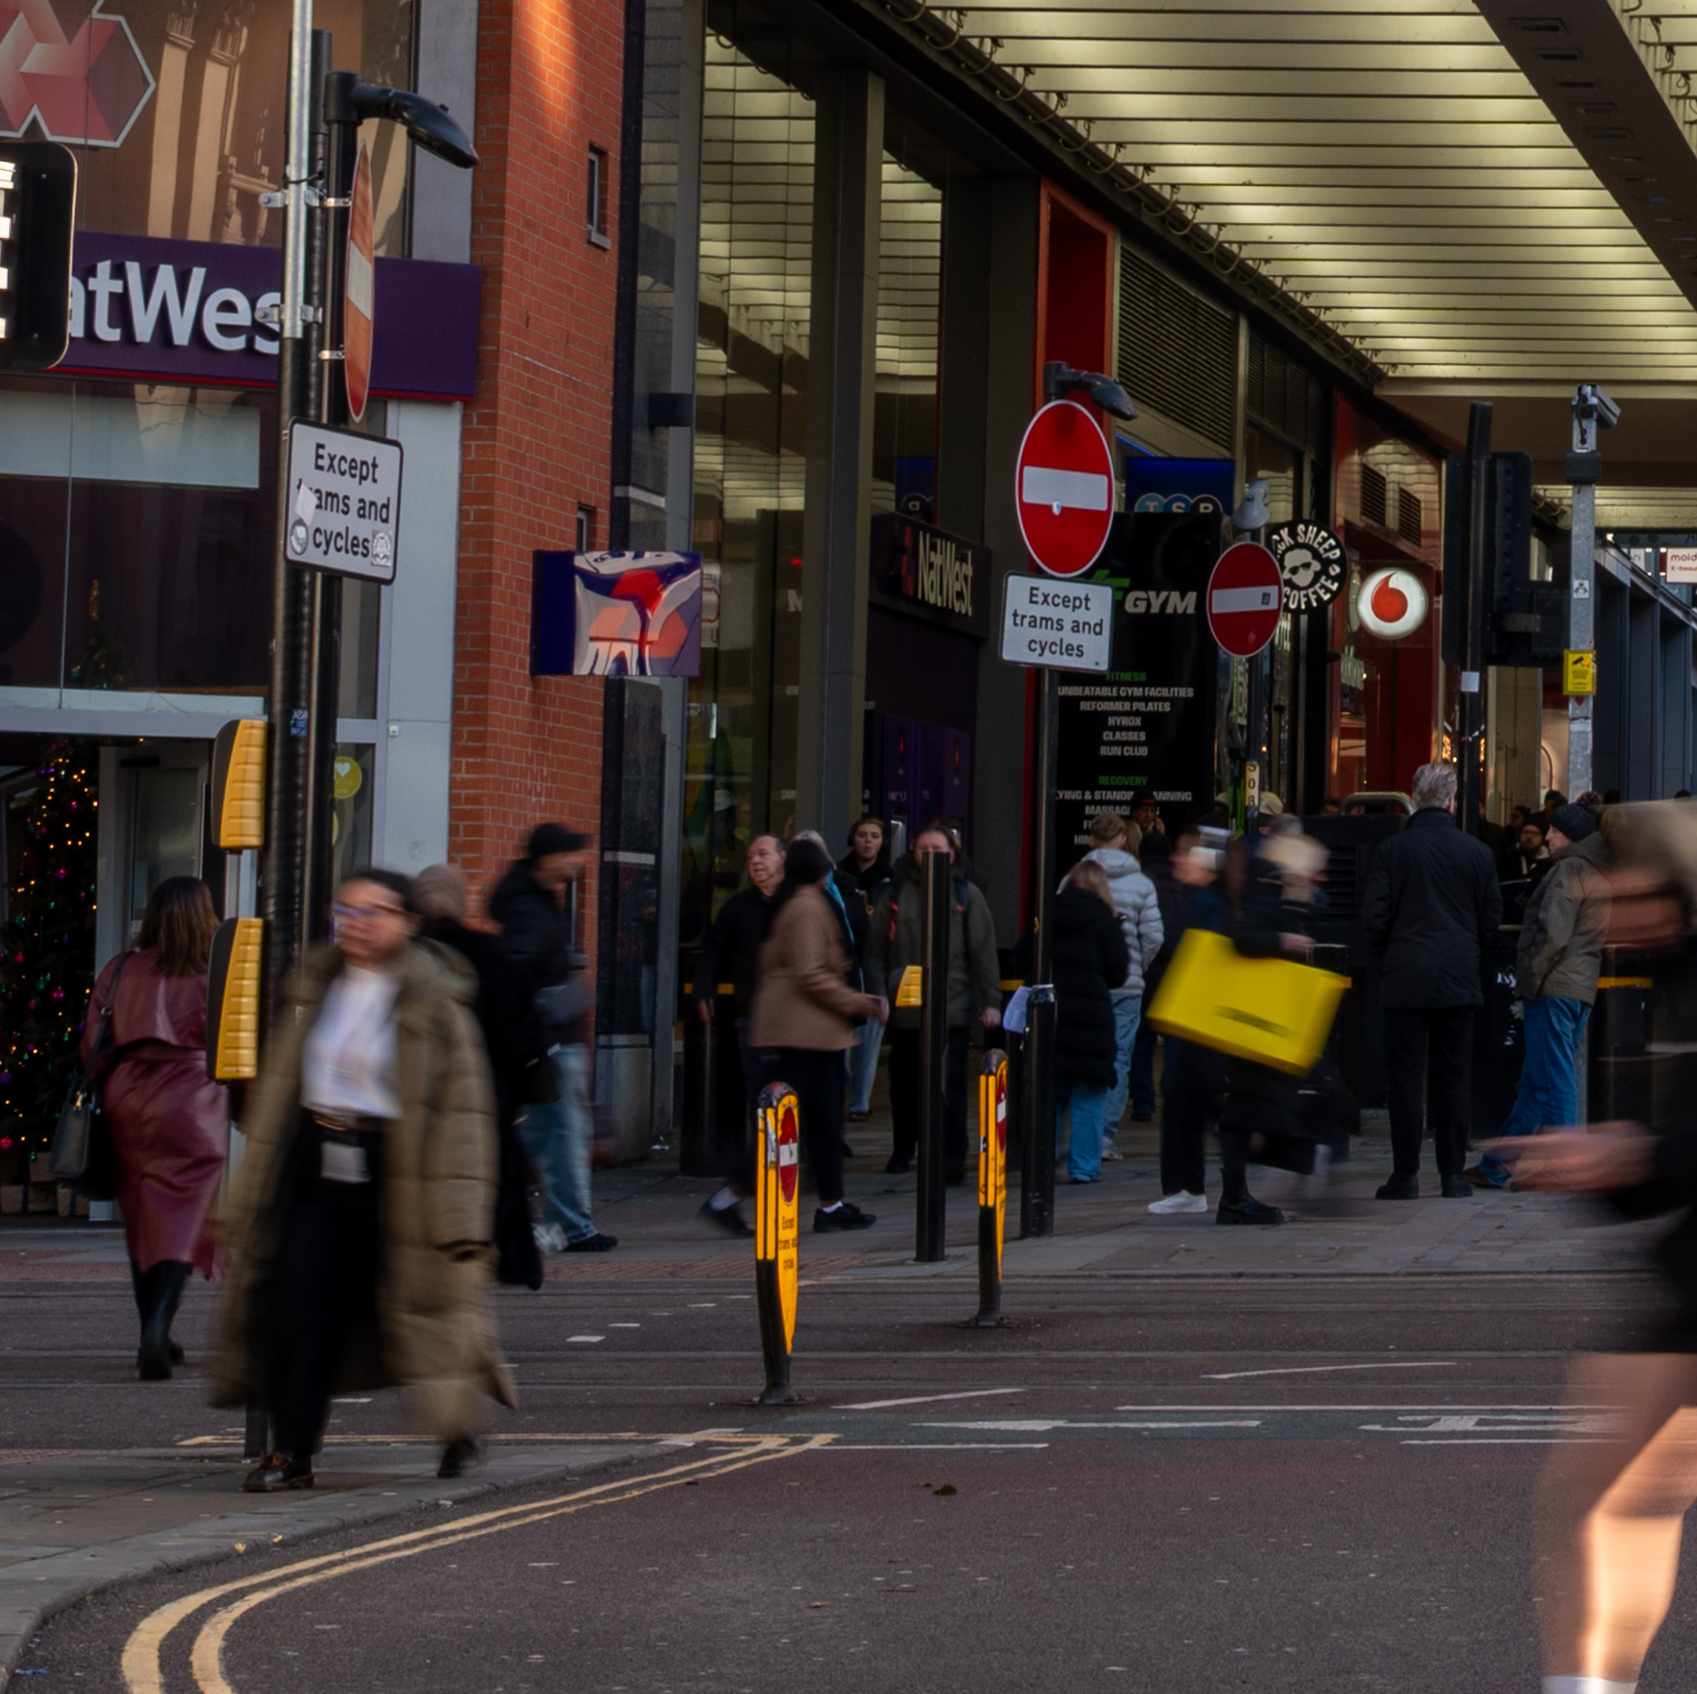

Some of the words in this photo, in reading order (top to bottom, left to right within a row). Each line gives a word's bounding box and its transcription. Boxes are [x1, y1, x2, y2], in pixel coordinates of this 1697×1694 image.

[71, 259, 281, 355] tWes
[314, 442, 379, 485] Except
[357, 496, 390, 524] and
[313, 526, 370, 558] cycles
[1297, 523, 1341, 560] SHEEP
[917, 530, 973, 617] NatWest
[1028, 586, 1091, 612] Except
[1124, 590, 1198, 614] GYM
[1283, 575, 1339, 610] COFFEE
[1012, 609, 1064, 631] trams
[1071, 619, 1103, 636] and
[1027, 637, 1085, 658] cycles
[1106, 671, 1147, 682] FITNESS
[1058, 685, 1118, 697] UNBEATABLE
[1119, 686, 1143, 697] GYM
[1144, 687, 1195, 698] FACILITIES
[1080, 701, 1131, 712] REFORMER
[1132, 702, 1171, 713] PILATES
[1108, 716, 1143, 727] HYROX
[1102, 731, 1147, 742] CLASSES
[1100, 746, 1121, 757] RUN
[1123, 746, 1149, 757] CLUB
[1098, 775, 1148, 786] RECOVERY
[1056, 789, 1083, 801] YING
[1152, 790, 1193, 802] ANNING
